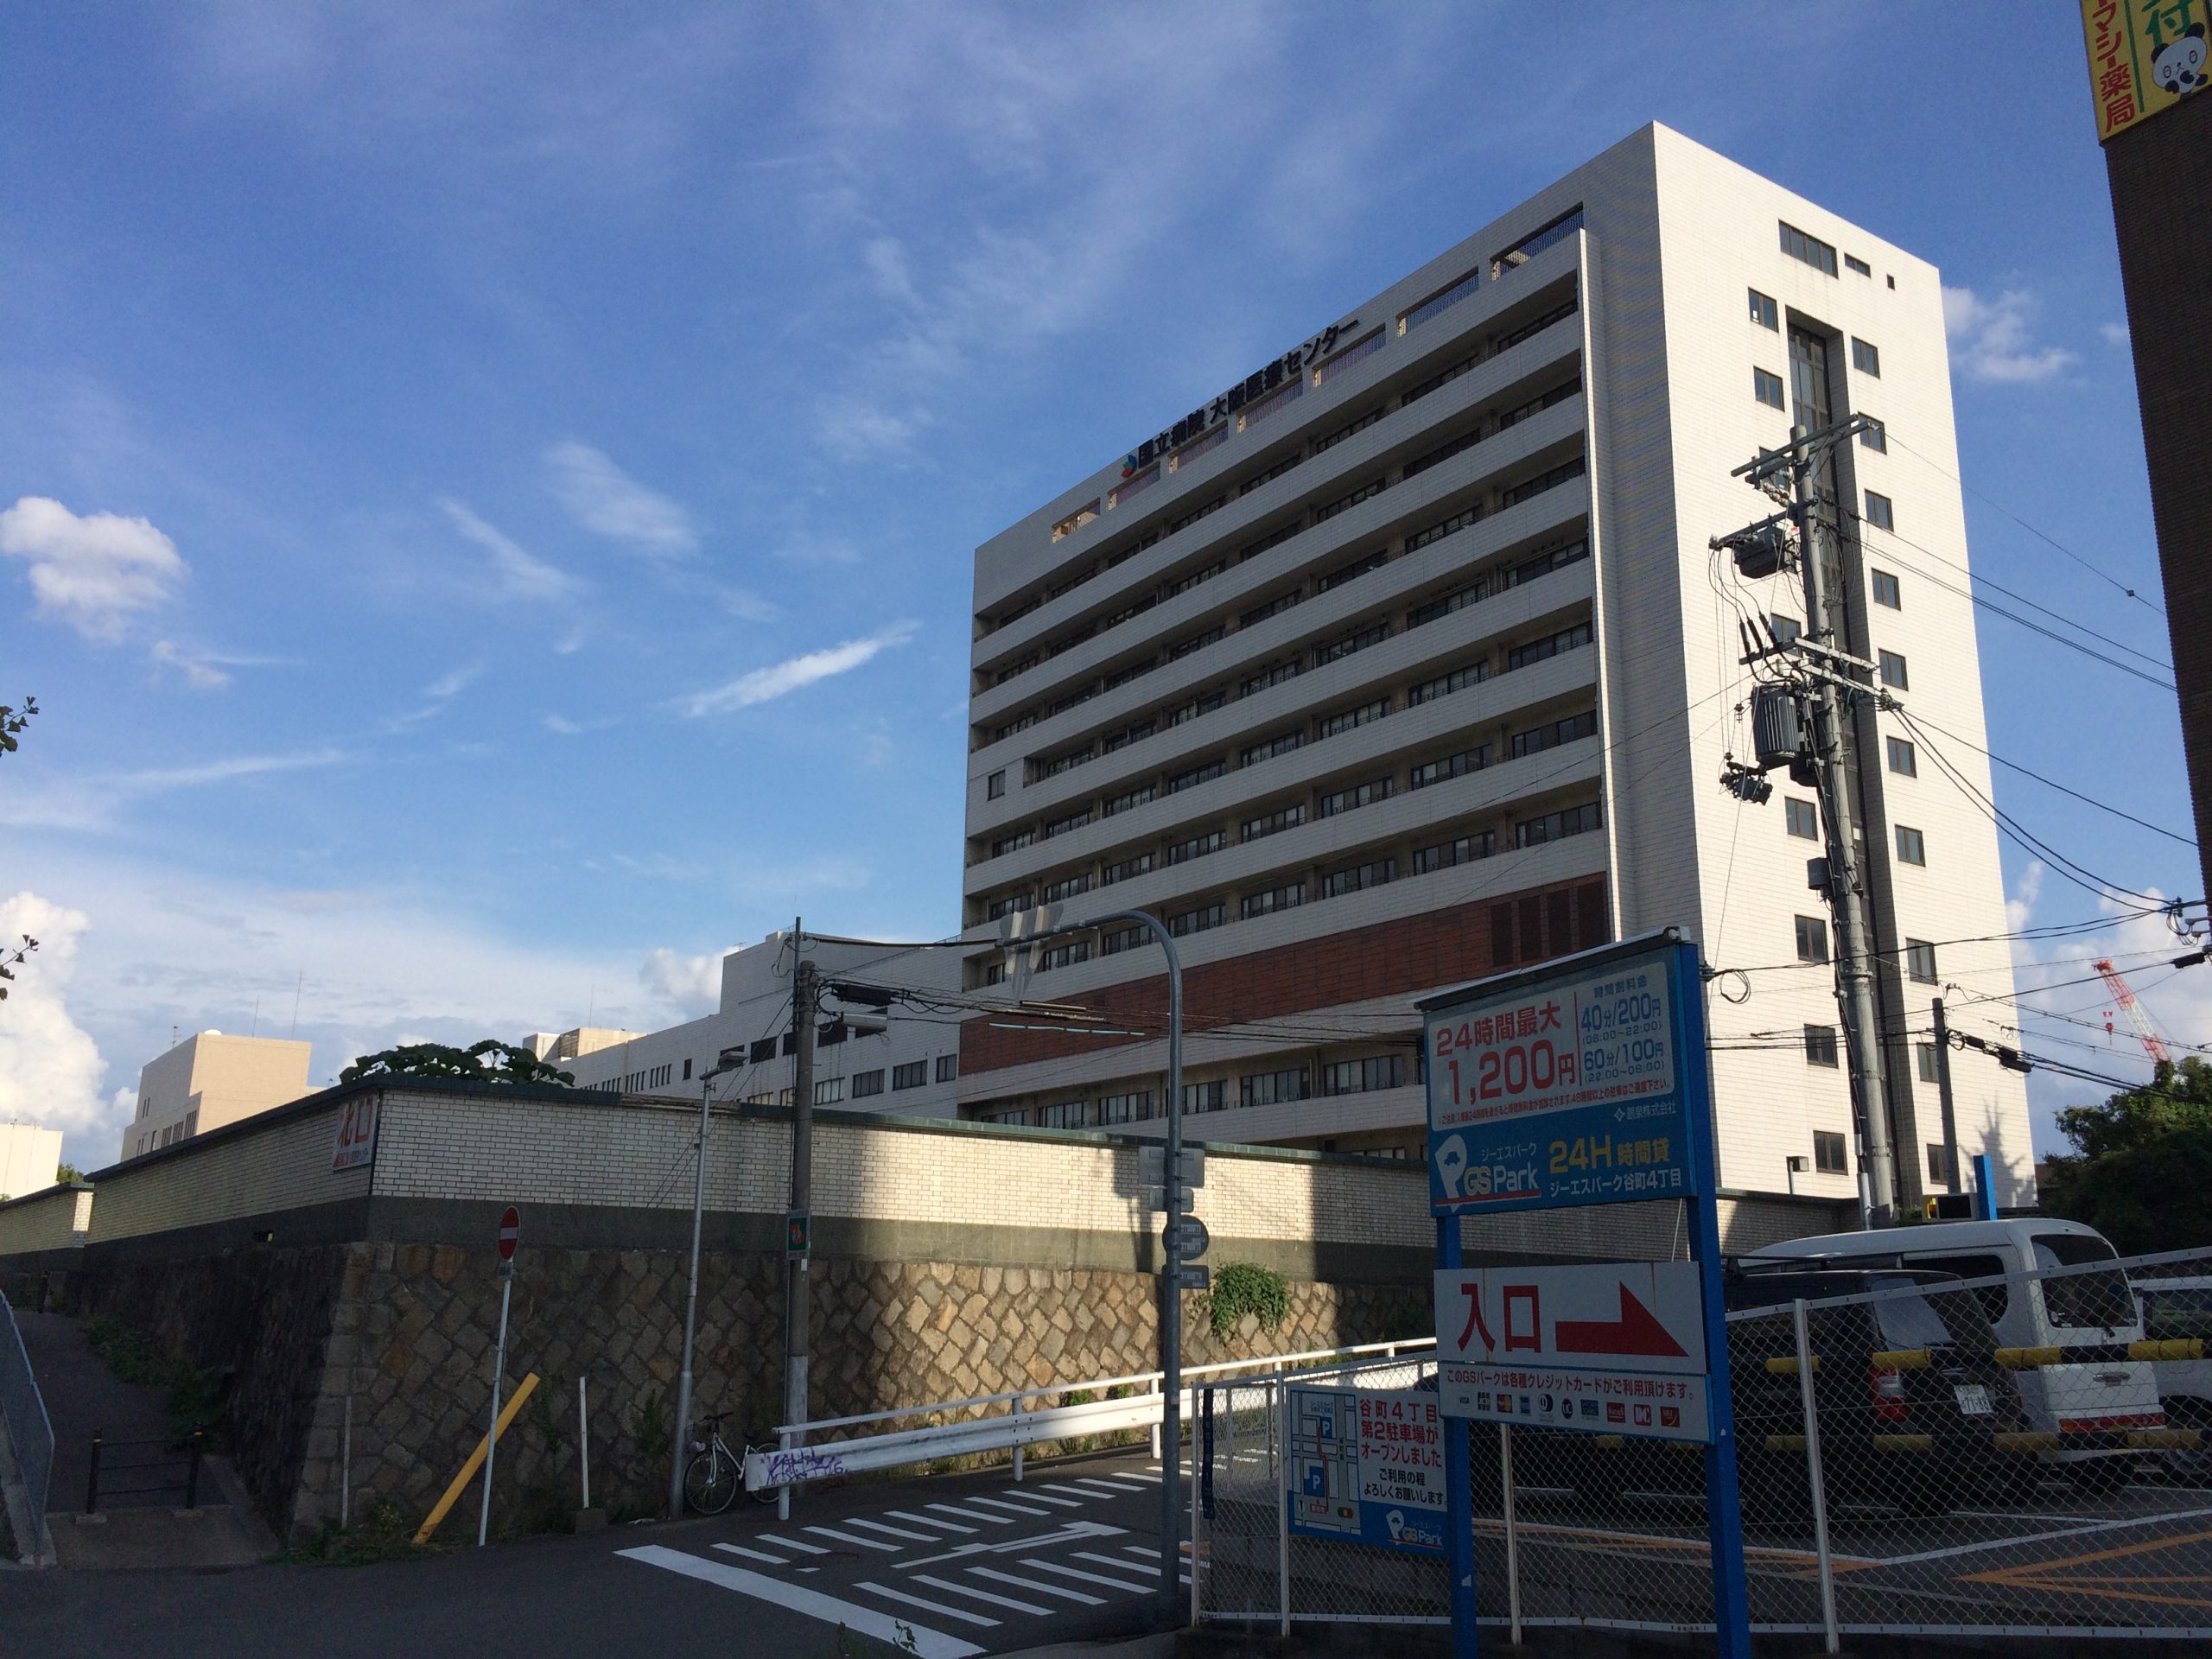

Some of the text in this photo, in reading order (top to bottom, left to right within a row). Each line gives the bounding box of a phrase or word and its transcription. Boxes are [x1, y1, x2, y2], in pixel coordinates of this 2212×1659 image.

[1580, 993, 1662, 1033] 40分/200円
[1436, 1001, 1561, 1057] 24時間最大
[1584, 1039, 1664, 1071] 60分/100円
[1448, 1039, 1575, 1105] 1,200円
[1481, 1142, 1537, 1162] ジーエスパーク
[1548, 1134, 1671, 1174] 24H 時間貸
[1549, 1167, 1682, 1198] ジーエスパーク谷町4丁目
[1457, 1282, 1542, 1353] 入口
[1359, 1398, 1437, 1423] 谷町4丁目
[1361, 1420, 1439, 1445] 第2駐車場が
[1361, 1442, 1442, 1468] オープンしました
[1379, 1468, 1426, 1486] ご利用の程
